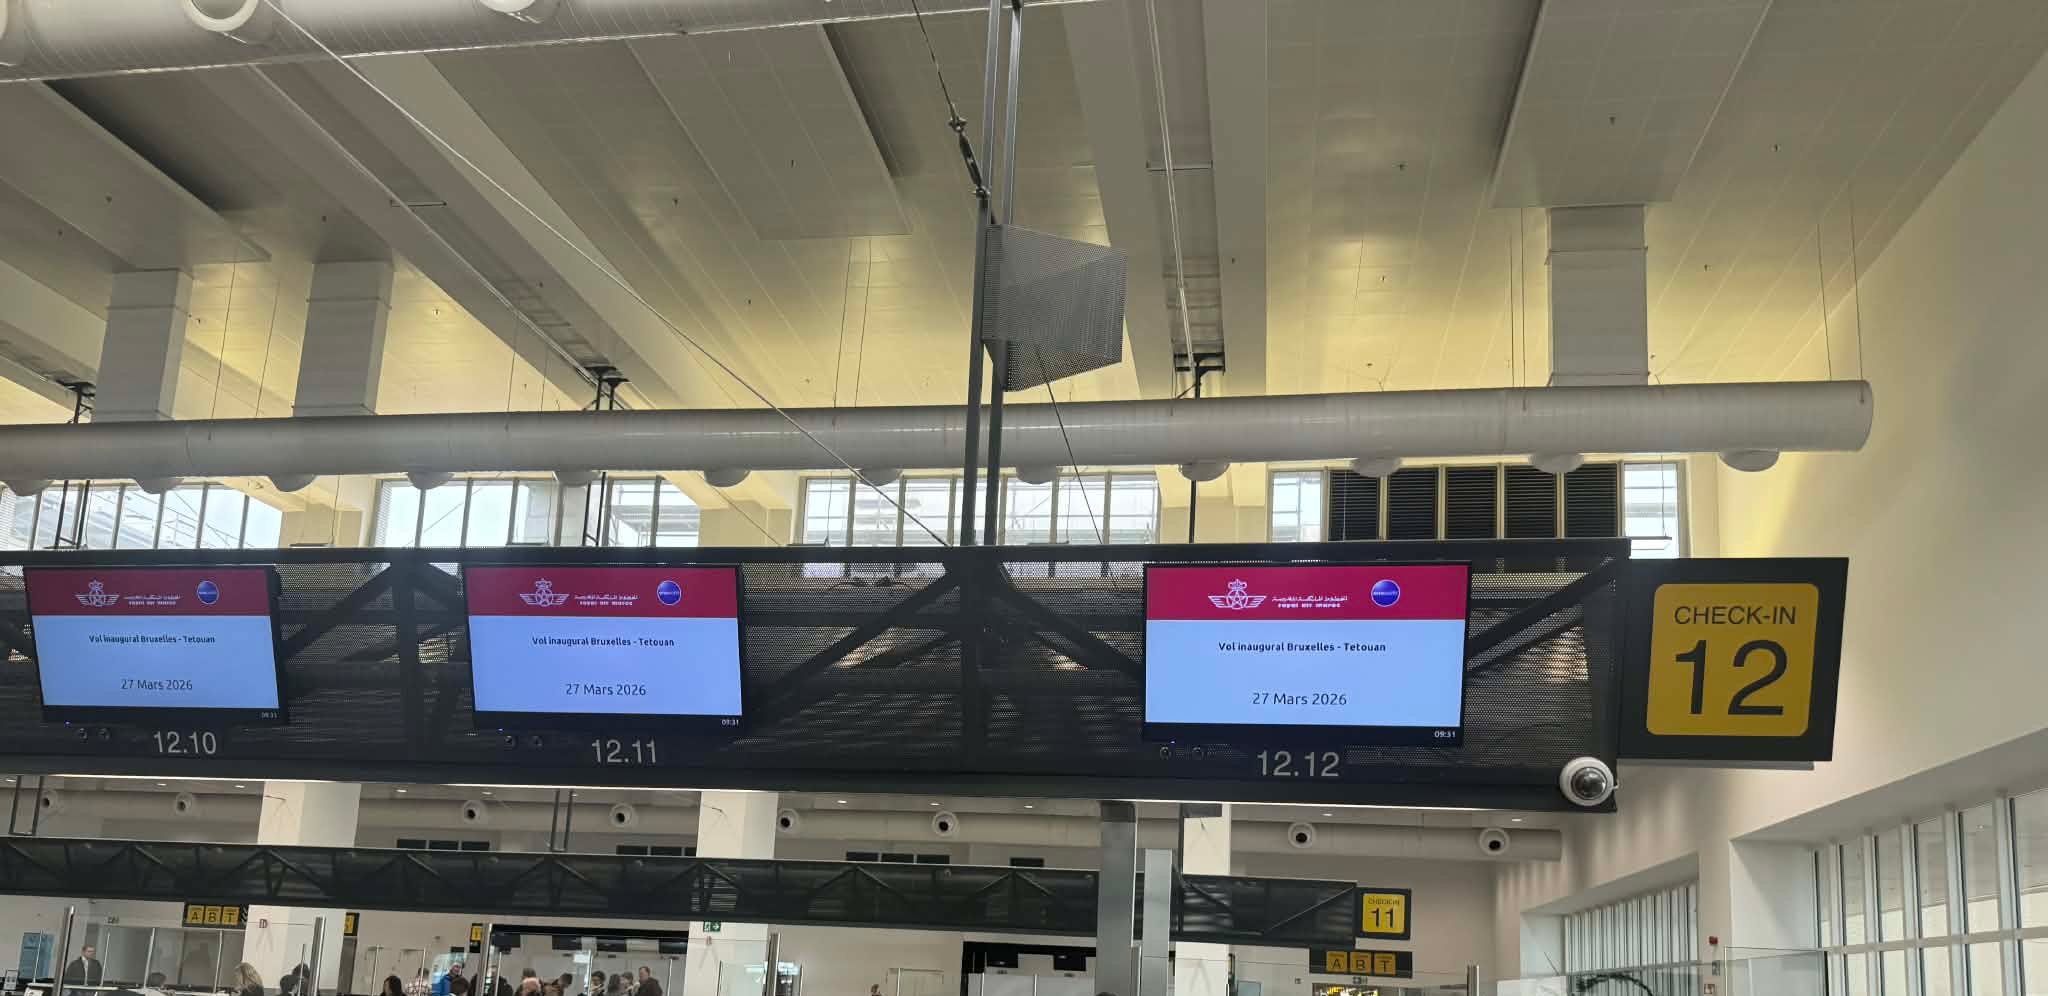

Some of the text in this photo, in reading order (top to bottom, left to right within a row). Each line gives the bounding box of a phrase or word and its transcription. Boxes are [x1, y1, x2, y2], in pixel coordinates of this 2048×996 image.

[1675, 605, 1796, 625] CHECK-IN
[89, 634, 102, 643] Vol
[103, 634, 139, 645] inaugural
[141, 634, 177, 643] Bruxelles
[184, 635, 215, 643] Tetouan
[532, 636, 547, 645] Vol
[549, 636, 589, 647] inaugural
[591, 637, 631, 646] Bruxelles
[639, 638, 675, 646] Tetouan
[1219, 642, 1236, 651] Vol
[1238, 642, 1284, 653] inaugural
[1287, 642, 1334, 651] Bruxelles
[1344, 643, 1386, 652] Tetouan
[1675, 639, 1787, 716] 12
[121, 679, 193, 690] 27 Mars 2026
[566, 684, 646, 696] 27 Mars 2026
[1253, 693, 1347, 705] 27 Mars 2026
[1434, 730, 1456, 738] 09:31
[153, 731, 216, 754] 12.10
[592, 740, 657, 764] 12.11
[1257, 751, 1340, 777] 12.12
[1371, 907, 1394, 928] 11
[1332, 958, 1342, 969] A
